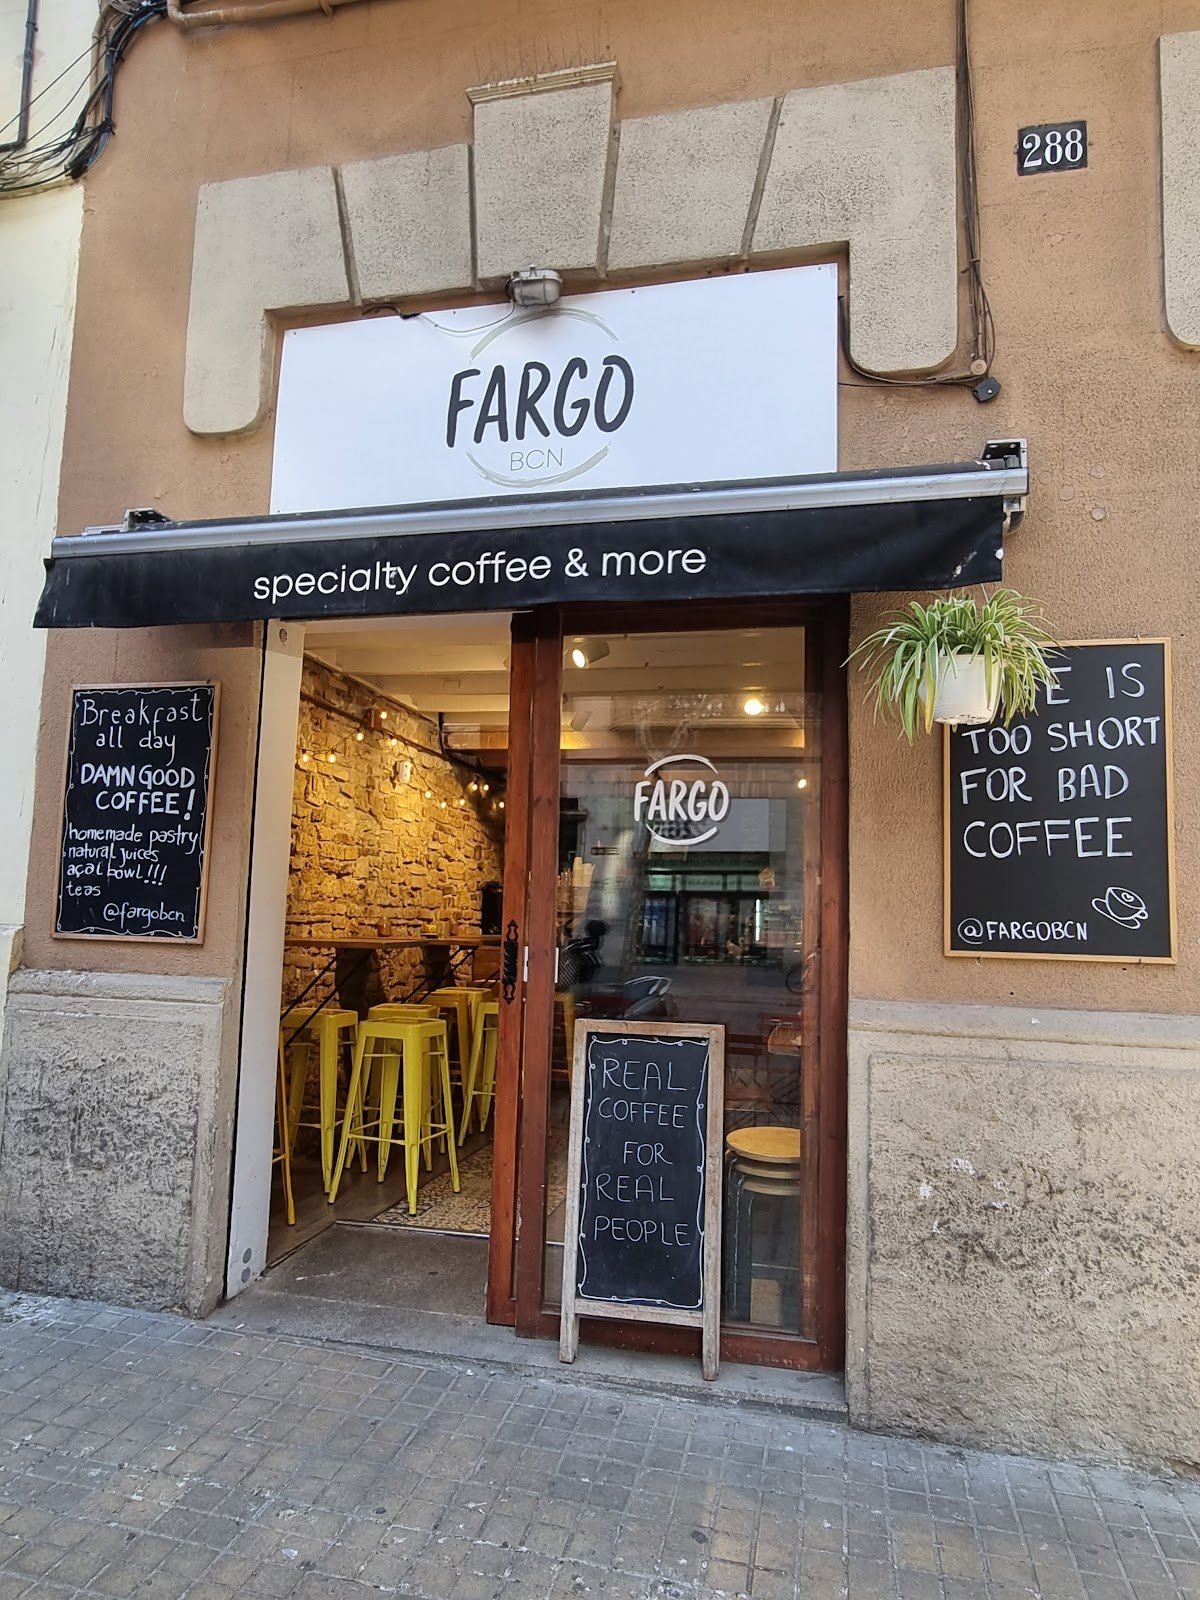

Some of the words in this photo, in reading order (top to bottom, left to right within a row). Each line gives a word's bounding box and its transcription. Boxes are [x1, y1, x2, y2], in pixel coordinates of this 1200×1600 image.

[1023, 129, 1083, 167] 288
[445, 354, 634, 448] FARGO
[509, 448, 564, 471] BCN
[253, 560, 418, 603] specialty
[428, 552, 551, 586] coffee
[565, 548, 588, 576] &
[601, 546, 707, 576] more
[1106, 663, 1144, 698] IS
[80, 694, 202, 734] Breakfast
[96, 727, 122, 748] all
[139, 730, 176, 766] day
[961, 725, 1032, 754] TOO
[1048, 716, 1160, 752] SHORT
[81, 763, 135, 787] DAMN
[139, 765, 195, 789] GOOD
[961, 767, 1032, 804] FOR
[1058, 764, 1129, 802] BAD
[634, 780, 729, 821] FARGO
[69, 822, 143, 842] homemade
[150, 825, 198, 855] pastry
[964, 817, 1132, 858] COFFEE
[68, 843, 115, 859] natural
[120, 847, 159, 867] juices
[66, 880, 101, 896] teas
[103, 902, 185, 928] @fargobcn
[958, 918, 1088, 944] @FARGOBCN
[603, 1058, 687, 1091] REAL
[599, 1098, 688, 1128] COFFEE
[624, 1141, 673, 1166] FOR
[596, 1173, 674, 1202] REAL
[594, 1216, 690, 1246] PEOPLE
